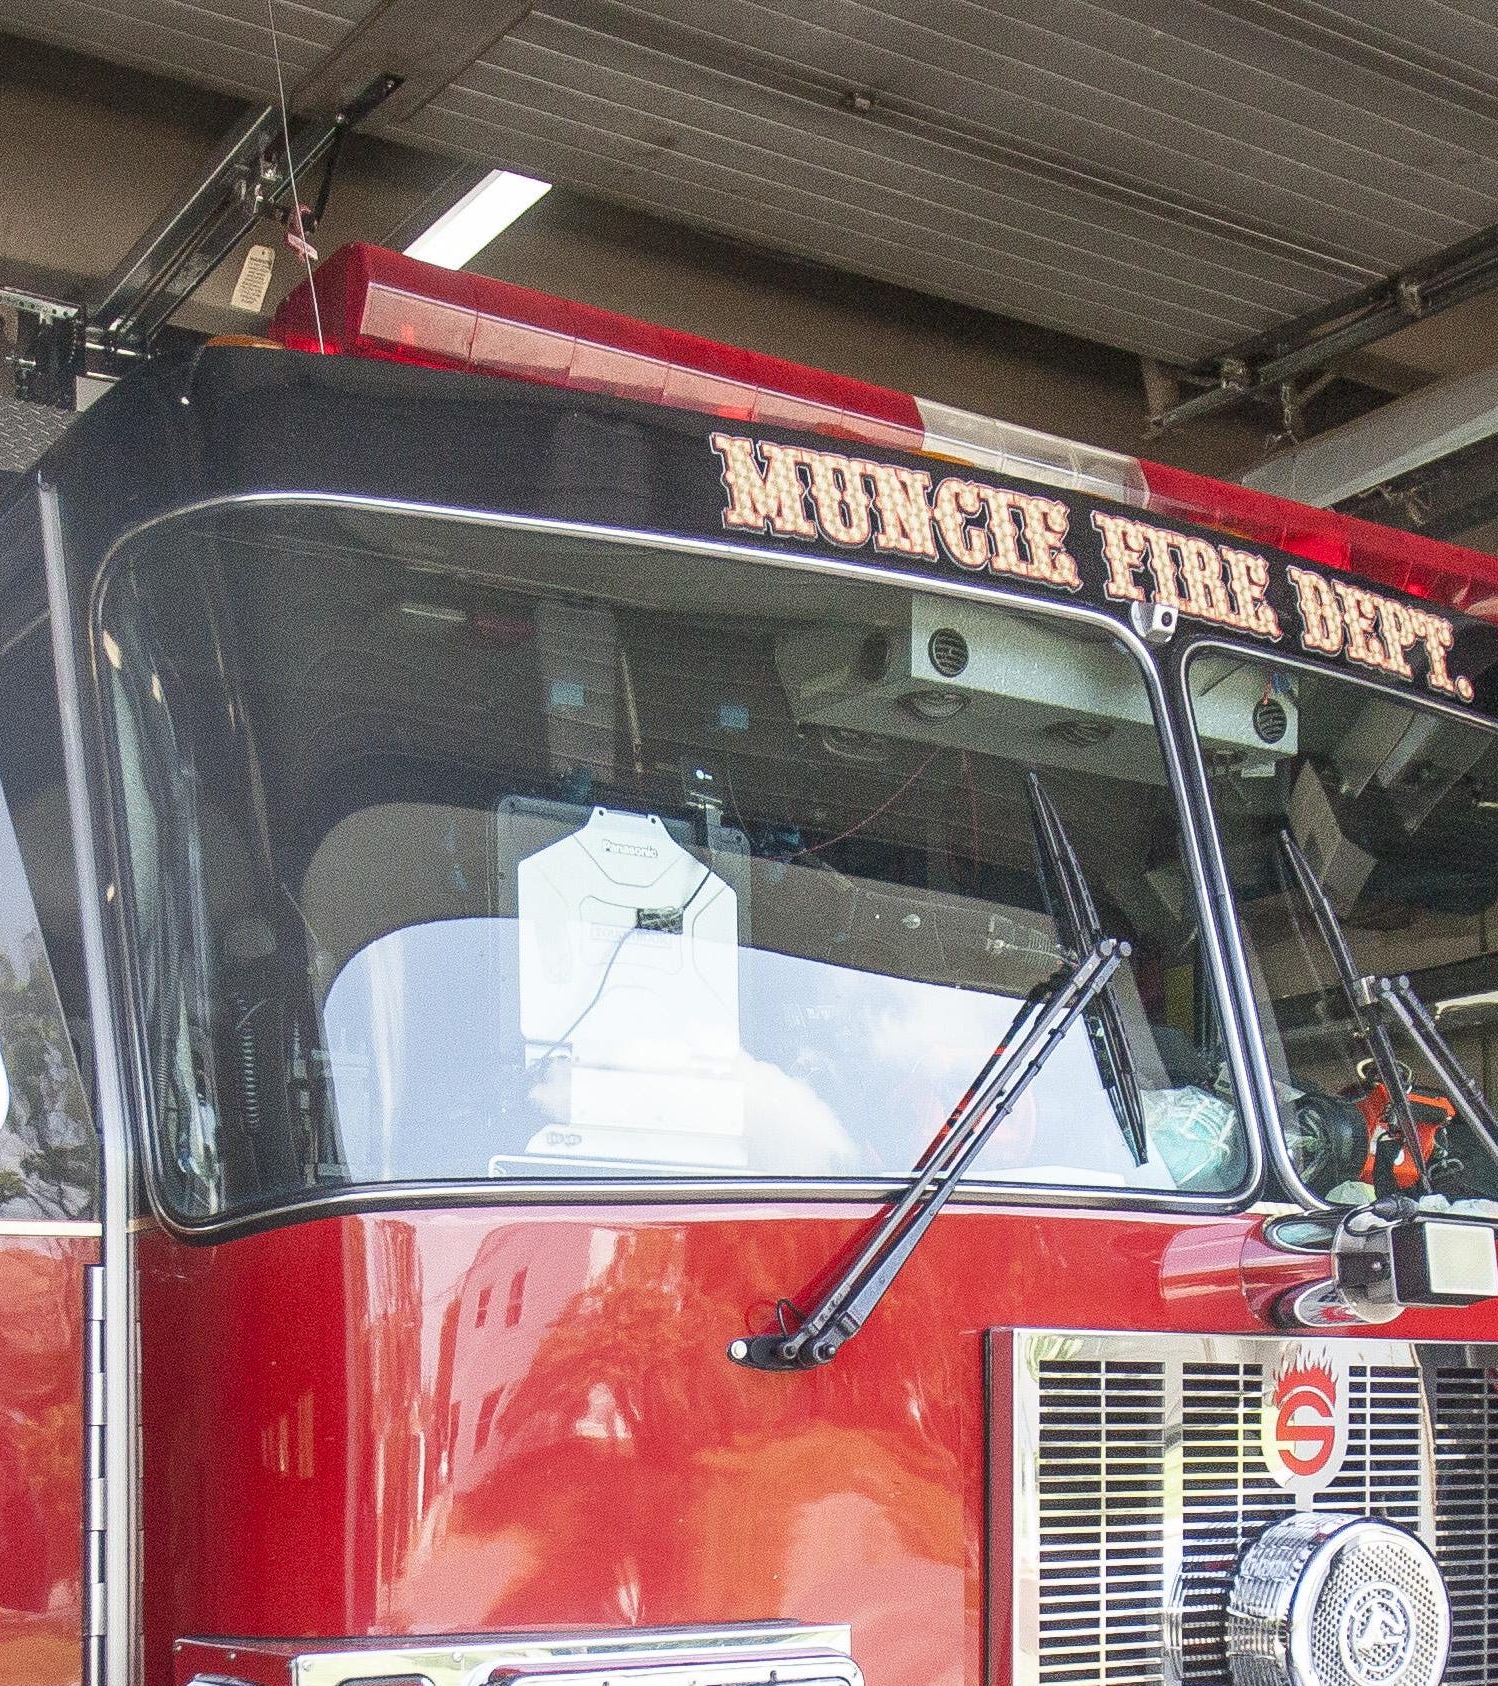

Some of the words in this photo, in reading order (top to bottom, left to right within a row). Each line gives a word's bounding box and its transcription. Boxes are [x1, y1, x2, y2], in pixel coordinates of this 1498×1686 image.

[710, 431, 1084, 592] MUNCIE
[1091, 508, 1283, 642] FIRE
[1286, 565, 1475, 703] DEPT.
[602, 838, 659, 859] Panasonic
